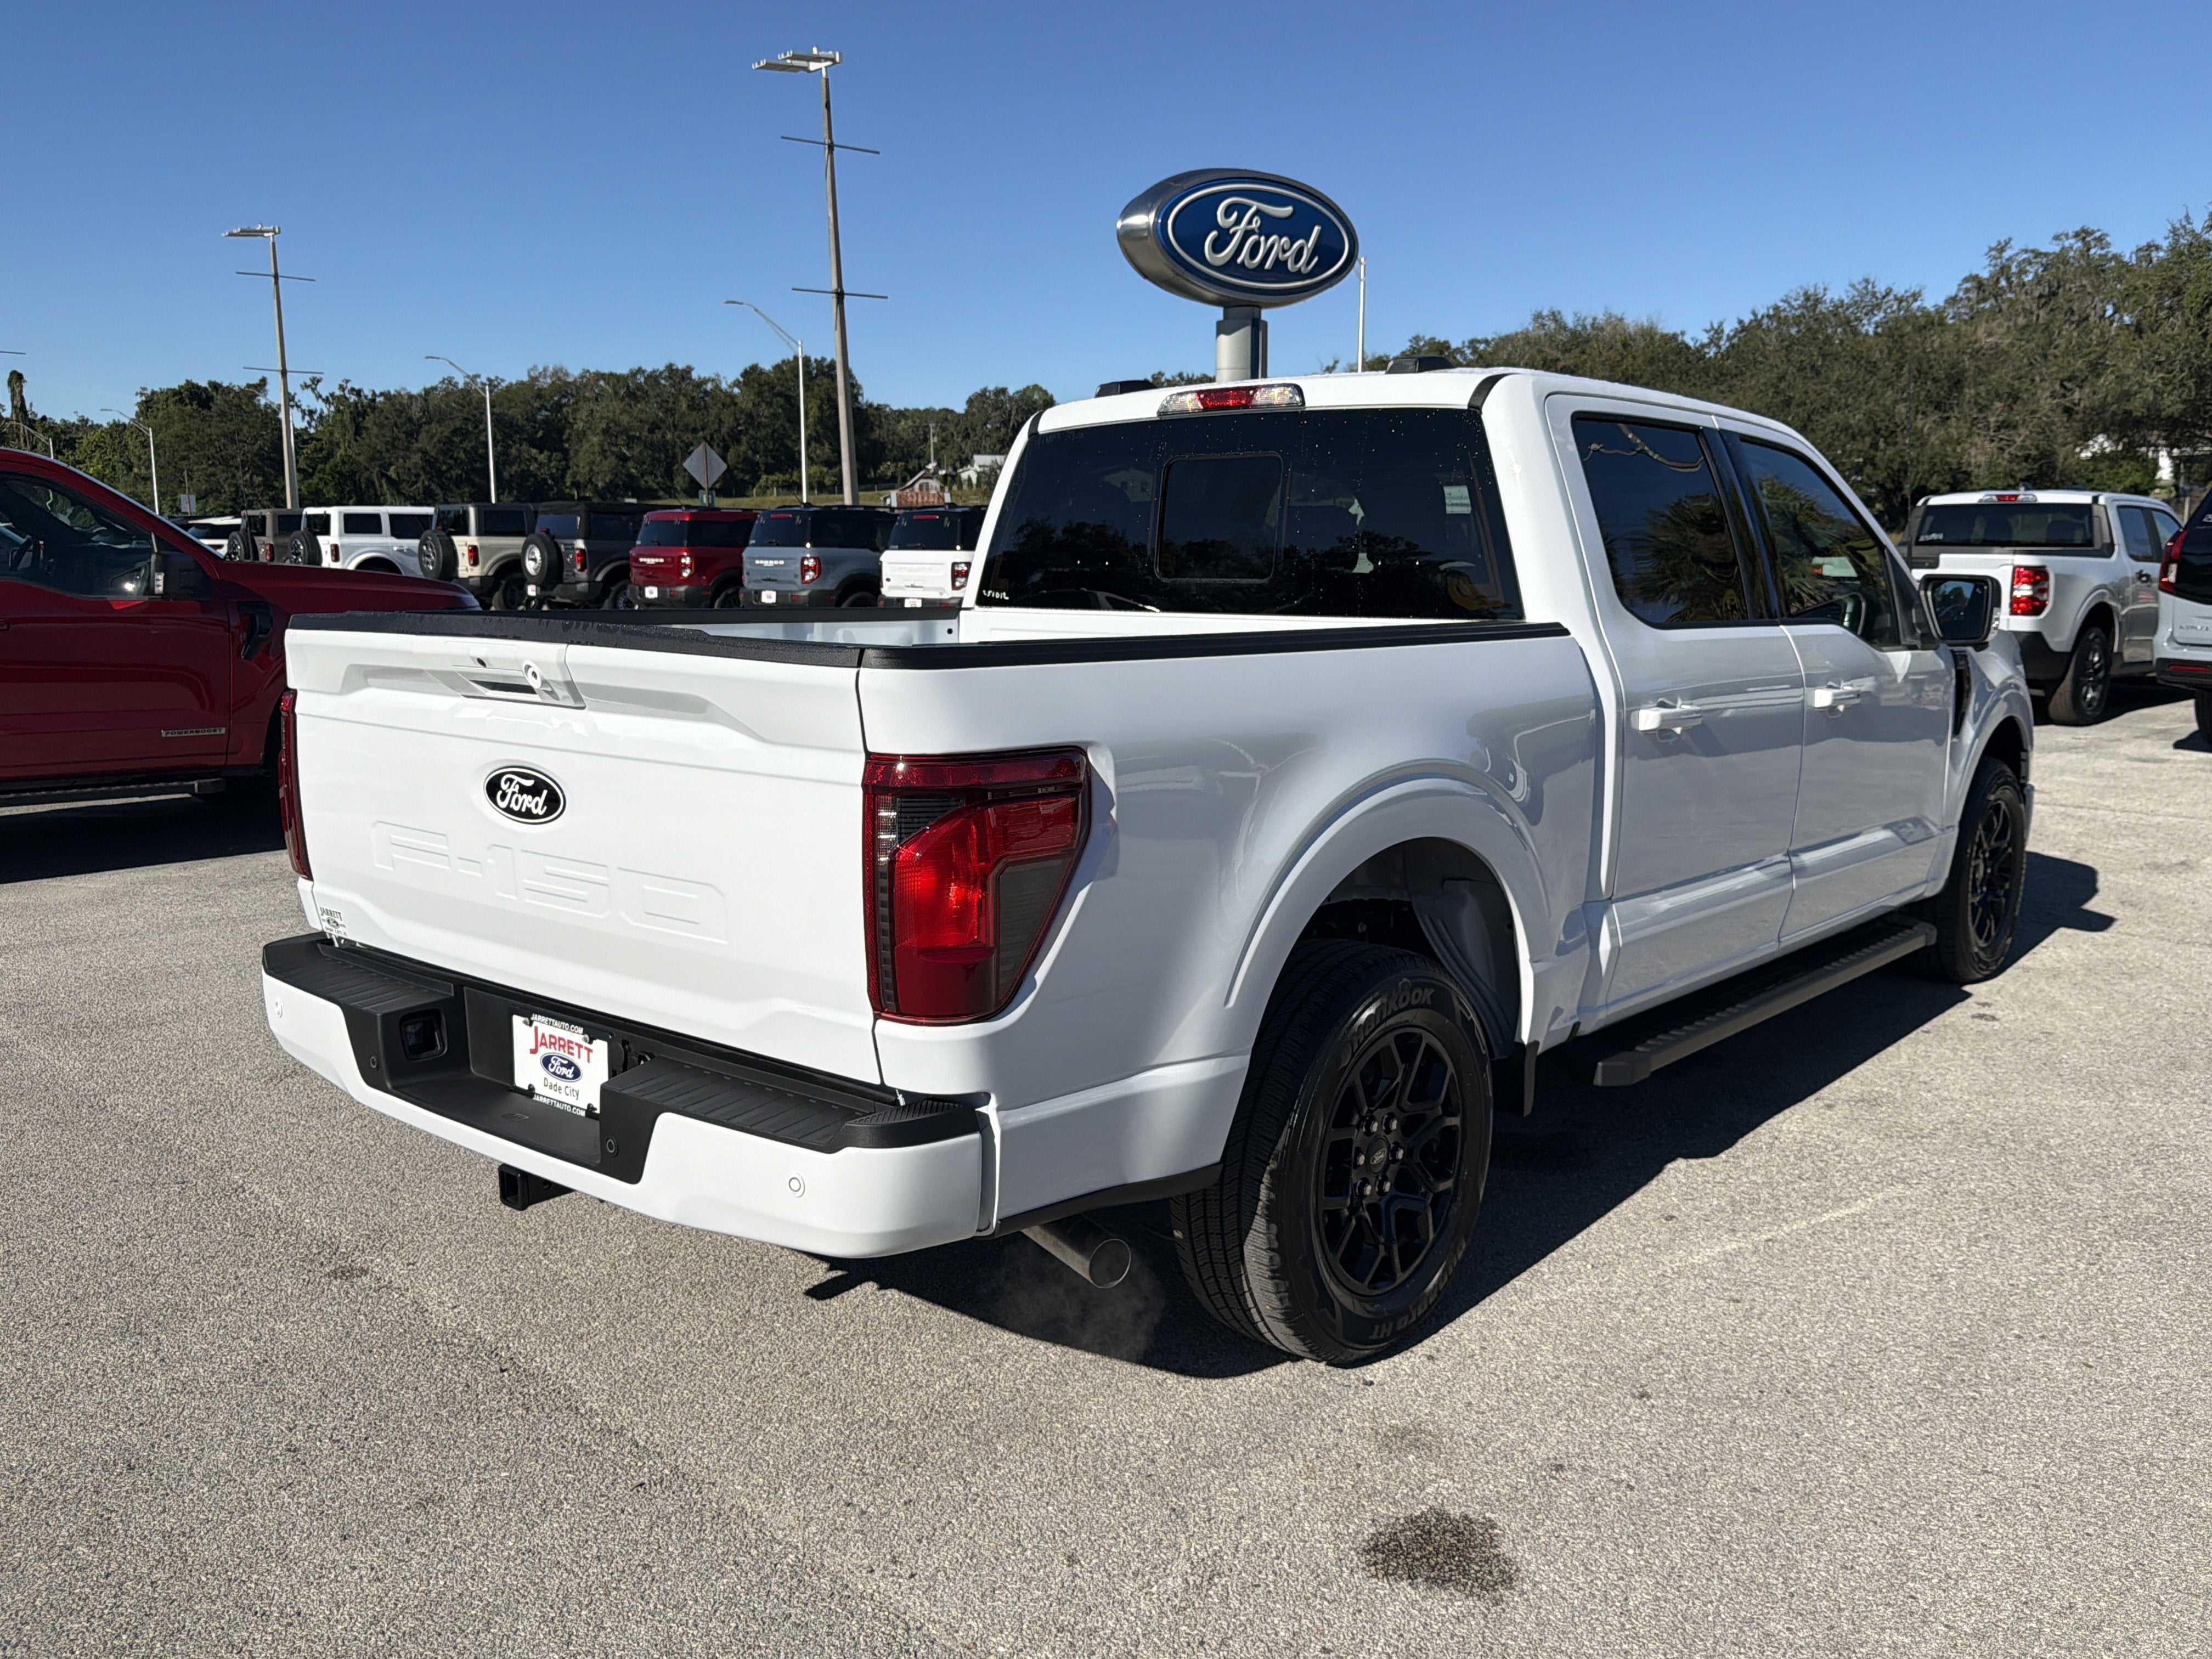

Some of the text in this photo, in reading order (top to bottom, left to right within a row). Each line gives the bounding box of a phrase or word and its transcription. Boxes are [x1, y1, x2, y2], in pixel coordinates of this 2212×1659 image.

[1204, 196, 1321, 274] Ford
[496, 773, 548, 815] Ford
[370, 820, 729, 945] F-150
[531, 1013, 584, 1034] JARRETTAUTO.COM
[529, 1026, 593, 1063] JARRETT
[548, 1056, 574, 1079] Ford
[543, 1077, 580, 1101] Dade City
[532, 1094, 586, 1117] JARRETTAUTO.COM
